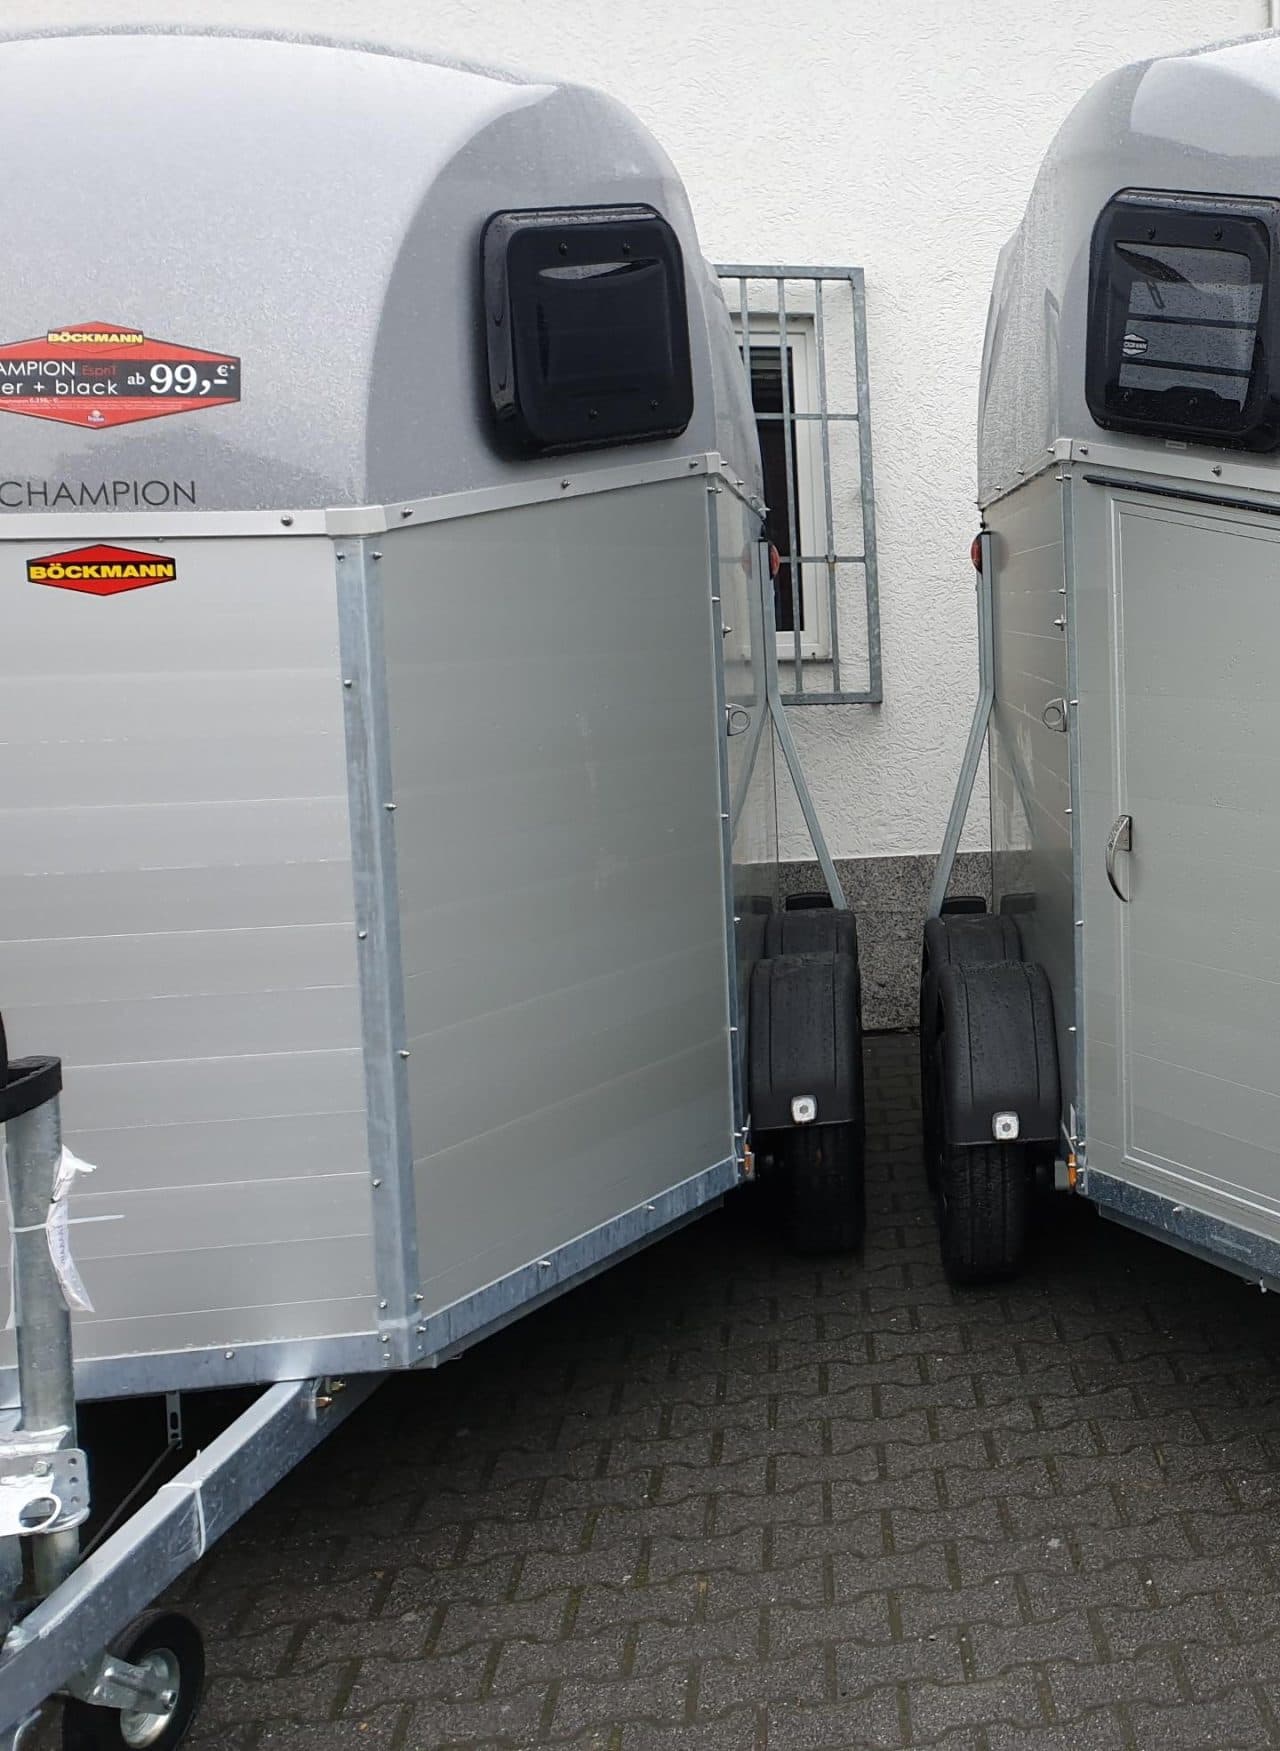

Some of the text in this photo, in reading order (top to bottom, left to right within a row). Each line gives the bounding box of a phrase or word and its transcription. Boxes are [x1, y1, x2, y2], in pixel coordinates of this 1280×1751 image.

[48, 332, 143, 343] BÖCKMANN
[127, 372, 145, 385] ab
[55, 379, 118, 395] black
[0, 480, 195, 507] CHAMPION
[29, 563, 173, 580] BÖCKMANN
